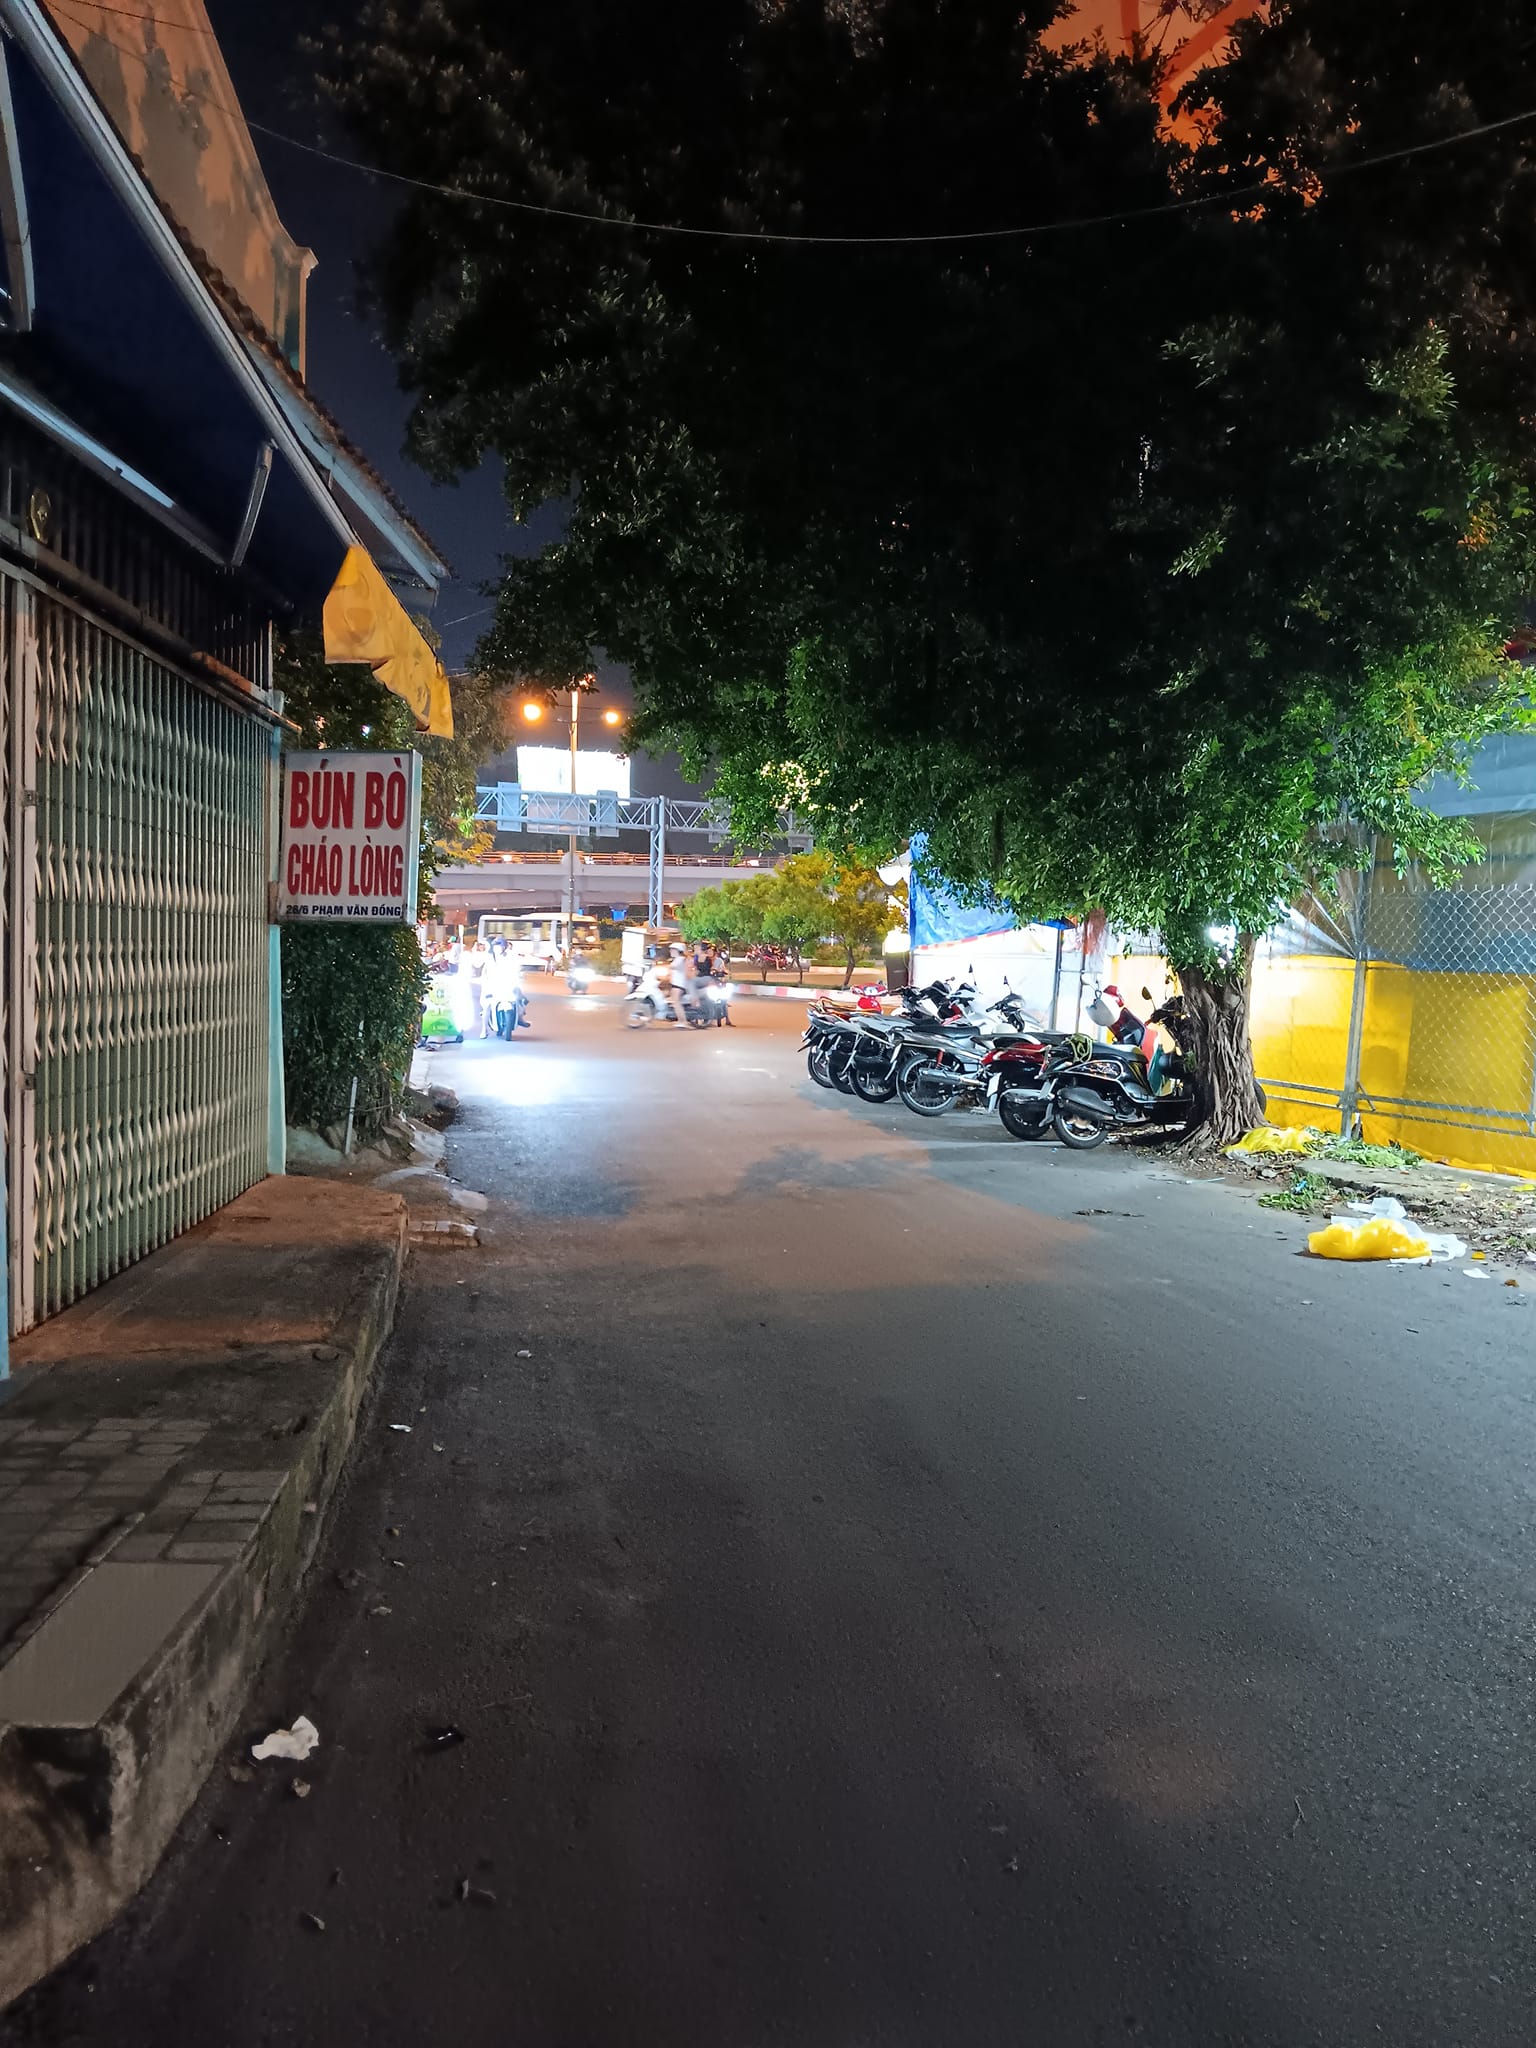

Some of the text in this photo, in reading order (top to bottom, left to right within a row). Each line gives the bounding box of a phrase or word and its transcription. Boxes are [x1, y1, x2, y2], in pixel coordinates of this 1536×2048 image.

[290, 757, 406, 829] BÚN BÒ
[287, 835, 404, 897] CHÁO LÒNG
[312, 905, 343, 917] PHẠM
[347, 904, 368, 916] VĂN
